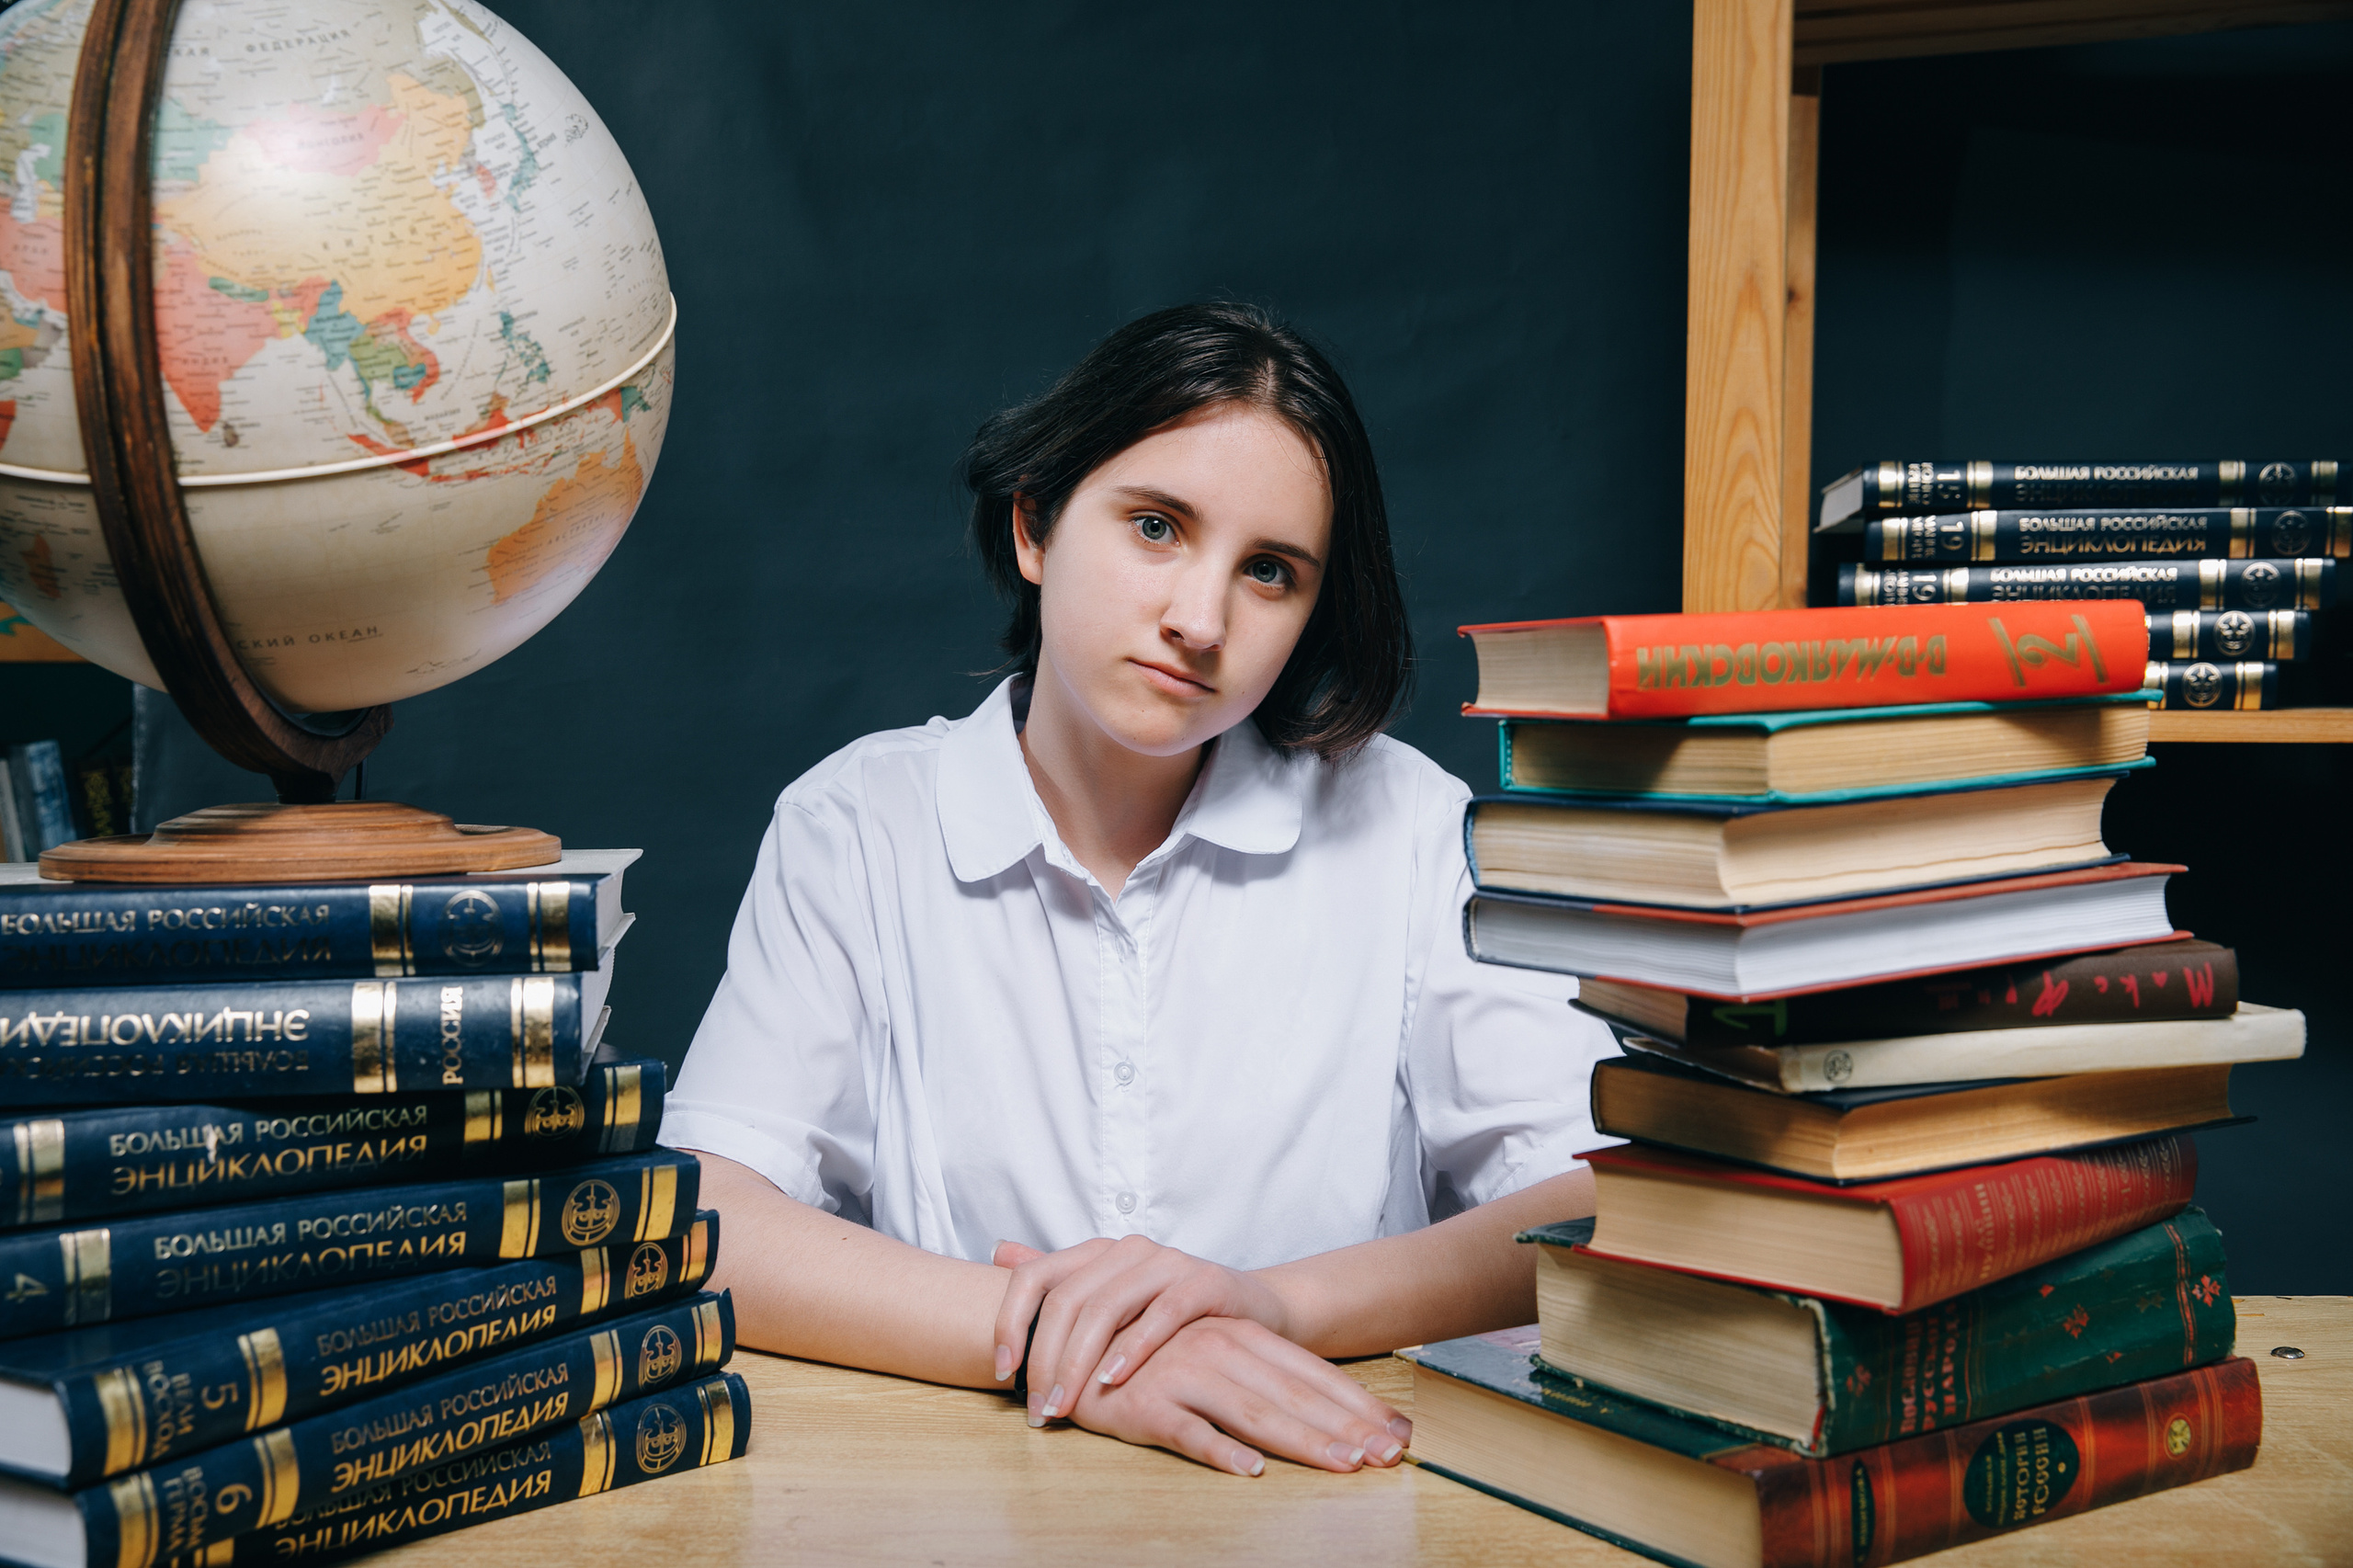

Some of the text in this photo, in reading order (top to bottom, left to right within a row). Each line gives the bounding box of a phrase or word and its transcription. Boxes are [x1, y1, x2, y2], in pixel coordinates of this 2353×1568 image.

[244, 29, 351, 53] ФЕДЕРАЦИЯ
[2014, 464, 2199, 481] БОЛЬШАЯ РОССИЙСКАЯ
[1939, 520, 1965, 551] 19
[2018, 514, 2208, 532] БОЛЬШАЯ РОССИЙСКАЯ
[2019, 536, 2207, 555] ЭНЦИКЛОПЕДИЯ
[1990, 566, 2178, 583] БОЛЬШАЯ РОССИЙСКАЯ
[308, 626, 378, 644] ОКЕАН
[1, 902, 330, 936] БОЛЬШАЯ РОССИЙСКАЯ
[440, 985, 463, 1085] РОССИЯ
[109, 1105, 428, 1157] БОЛЬШАЯ РОССИЙСКАЯ
[109, 1134, 428, 1196] ЭНЦИКЛОПЕДИЯ
[153, 1200, 467, 1260] БОЛЬШАЯ РОССИЙСКАЯ
[5, 1263, 51, 1304] 4
[154, 1231, 467, 1299] ЭНЦИКЛОПЕДИЯ
[316, 1275, 557, 1358] БОЛЬШАЯ РОССИЙСКАЯ
[319, 1304, 557, 1397] ЭНЦИКЛОПЕДИЯ
[201, 1381, 239, 1410] 5
[331, 1362, 569, 1455] БОЛЬШАЯ РОССИЙСКАЯ
[331, 1391, 569, 1494] ЭНЦИКЛОПЕДИЯ
[402, 1441, 551, 1497] РОССИЙСКАЯ
[2013, 1432, 2029, 1521] ИСТОРИИ
[2032, 1426, 2050, 1516] РОССИИ
[215, 1483, 253, 1515] 6
[275, 1470, 552, 1561] ЭНЦИКЛОПЕДИЯ
